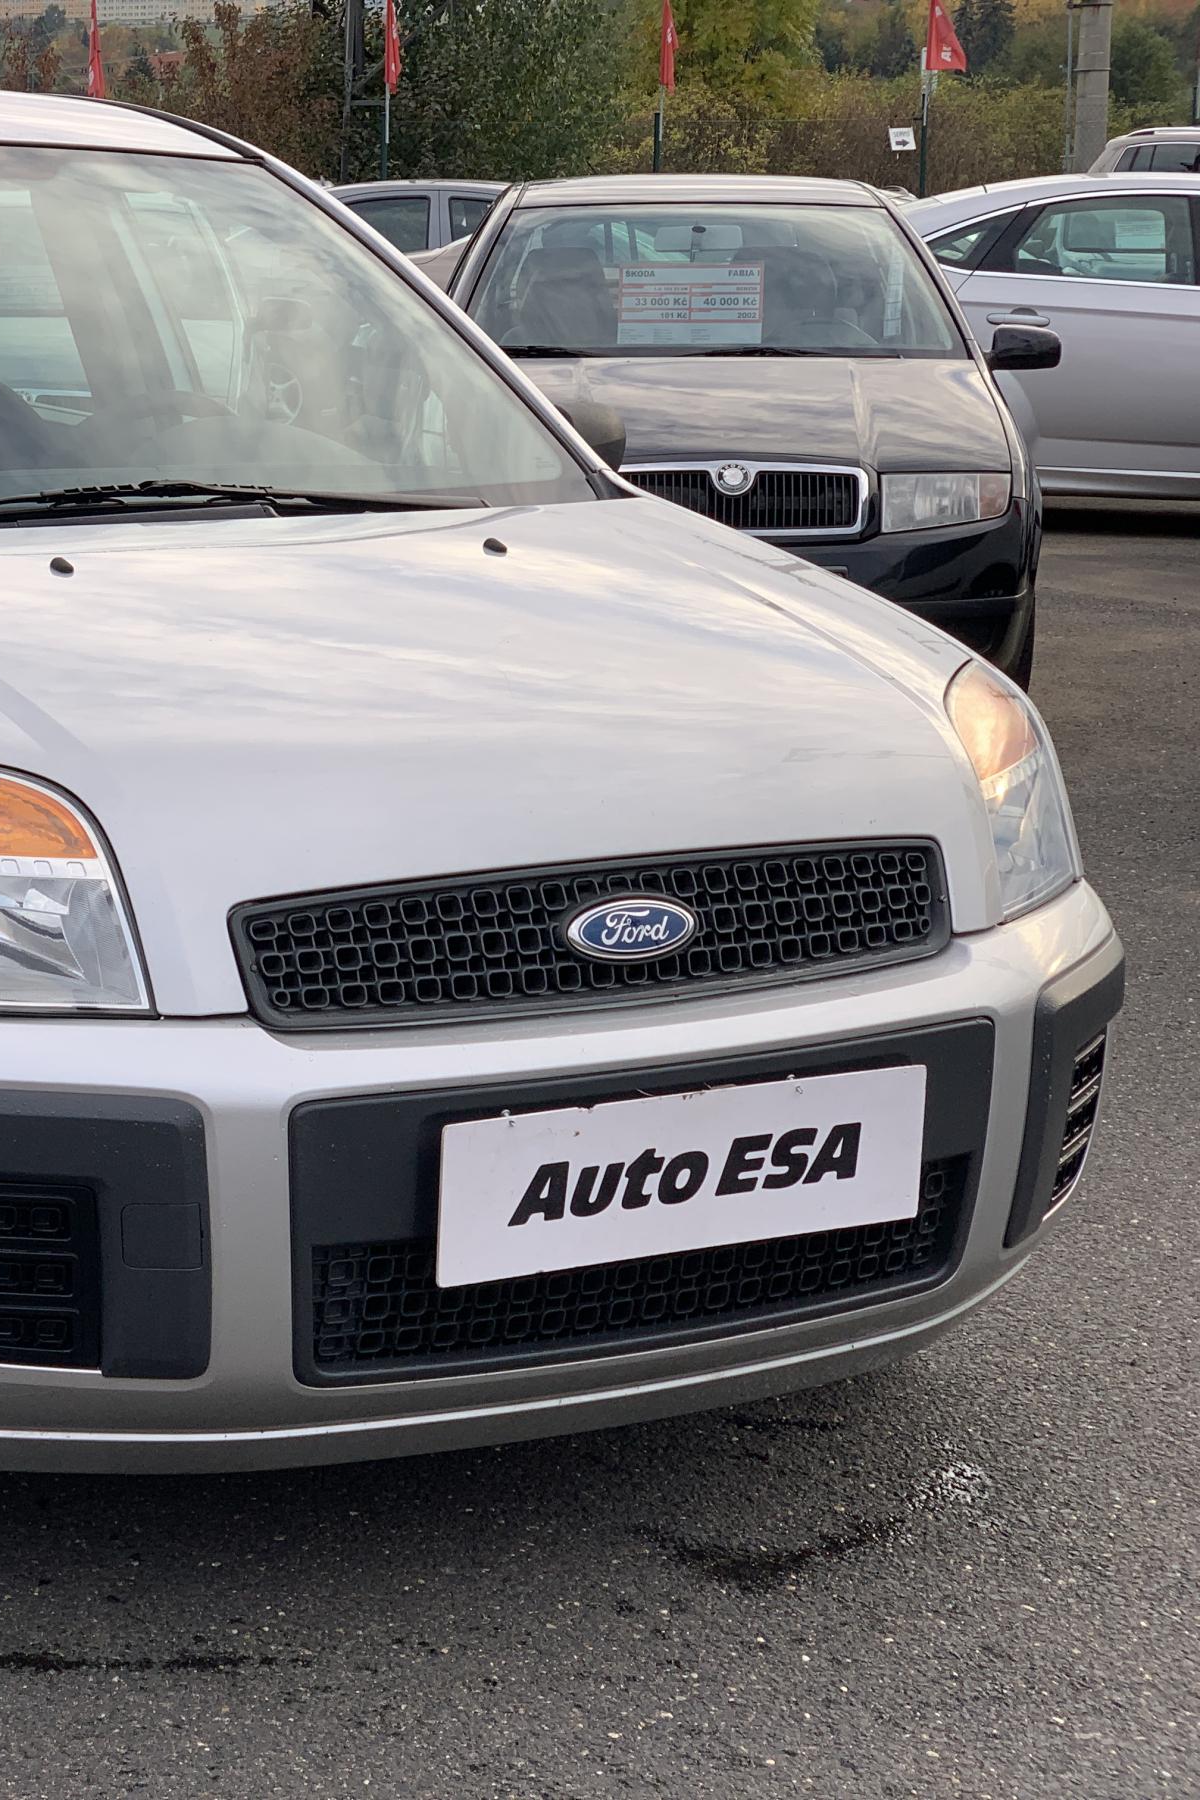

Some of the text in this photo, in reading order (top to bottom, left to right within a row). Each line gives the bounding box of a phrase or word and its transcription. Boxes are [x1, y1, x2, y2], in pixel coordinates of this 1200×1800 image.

[728, 269, 755, 277] FABIA
[651, 298, 670, 306] 000
[673, 297, 688, 306] Kč
[704, 297, 758, 306] 40 000 Kč
[601, 910, 670, 945] Ford
[507, 1122, 862, 1227] Auto ESA
